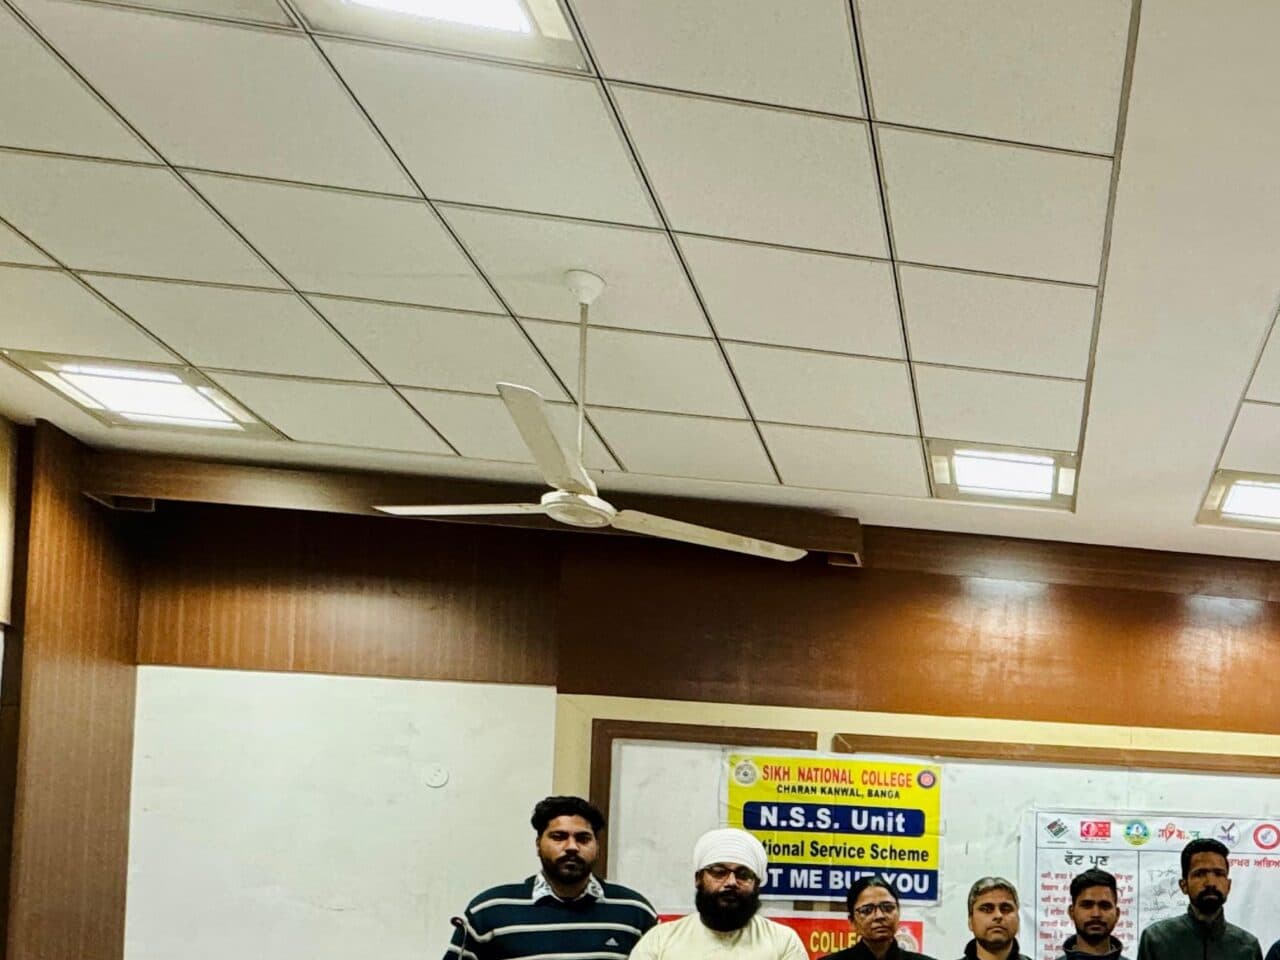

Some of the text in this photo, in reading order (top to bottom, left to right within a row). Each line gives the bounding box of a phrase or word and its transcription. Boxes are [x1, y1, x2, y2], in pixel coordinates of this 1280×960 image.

[763, 765, 912, 788] SIKH NATIONAL COLLEGE
[777, 784, 900, 799] CHARAN KANWAL, BANGA
[760, 805, 906, 833] N.S.S. Unit
[763, 841, 929, 862] tional Service Scheme
[790, 869, 823, 889] ME
[882, 873, 929, 894] YOU
